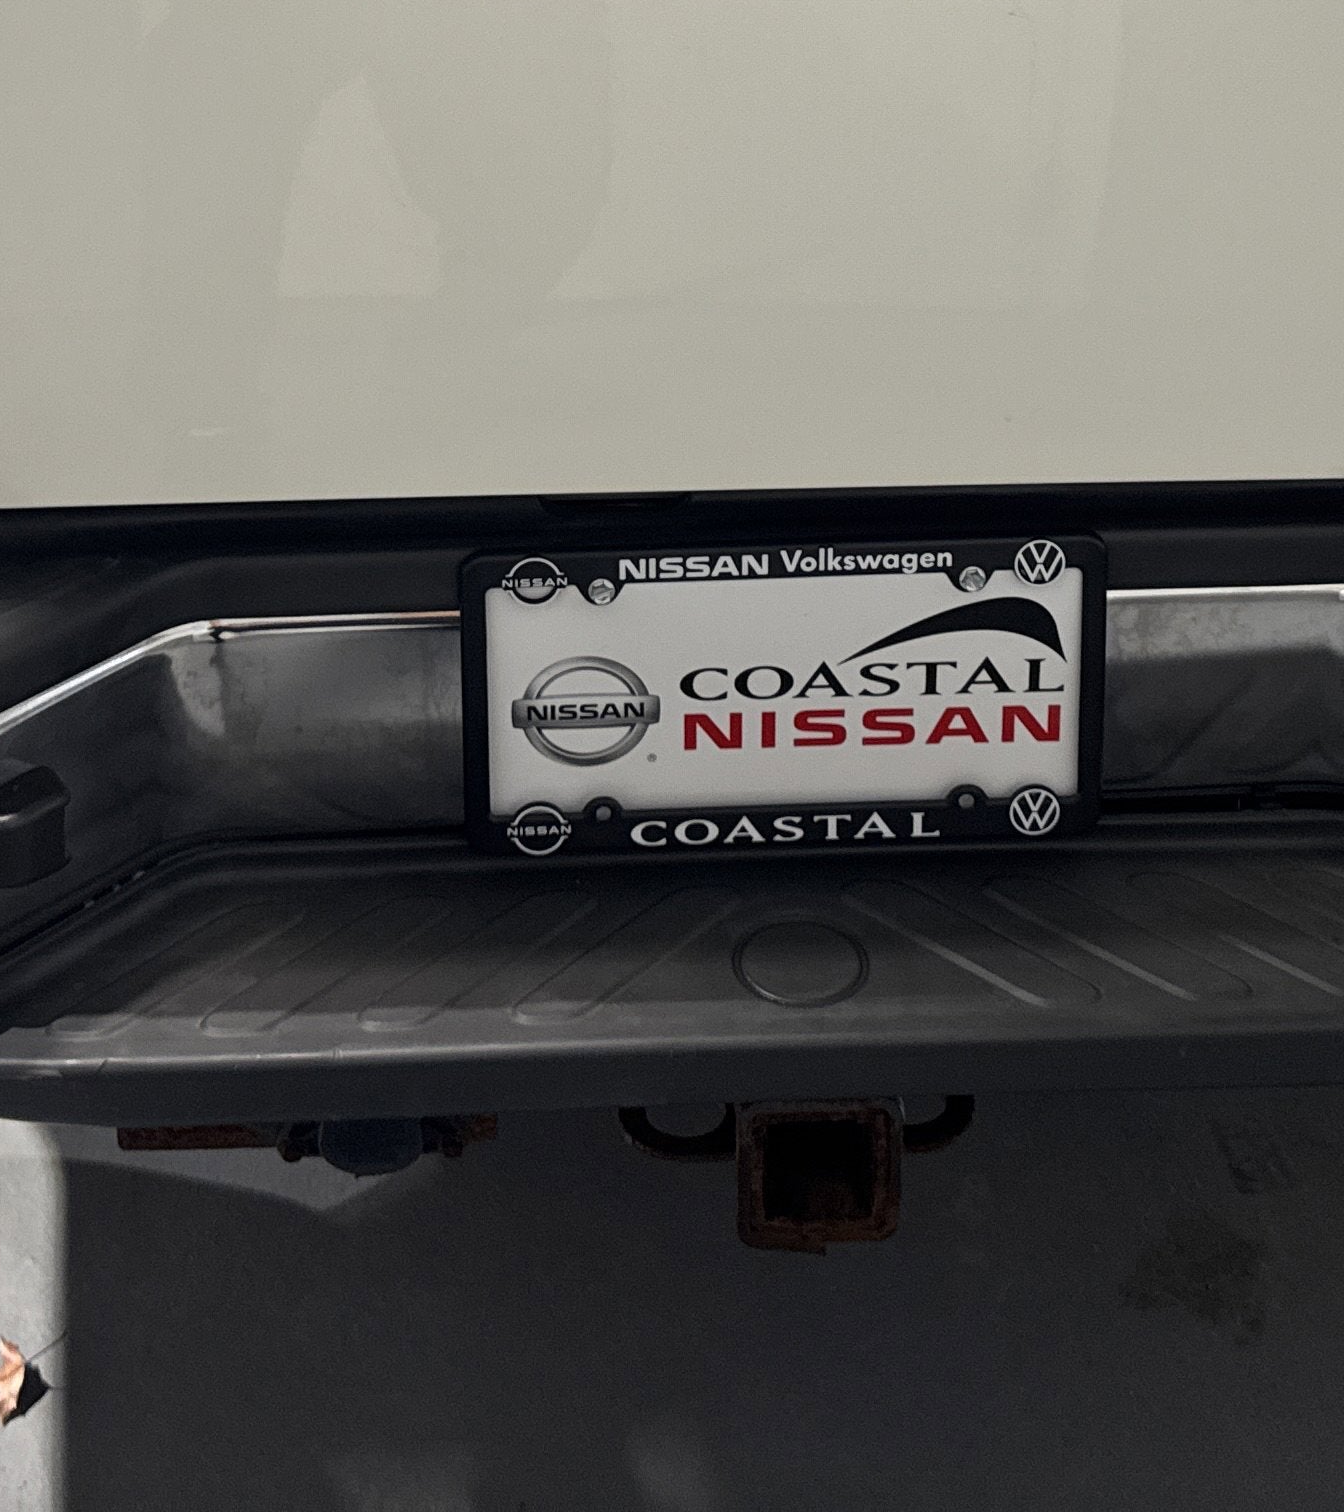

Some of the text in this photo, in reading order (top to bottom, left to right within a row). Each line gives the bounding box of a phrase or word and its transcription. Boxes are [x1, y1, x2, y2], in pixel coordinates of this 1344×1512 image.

[618, 546, 953, 581] NISSAN Volkswagen
[501, 577, 568, 589] NISSAN
[679, 656, 1065, 701] COASTAL
[527, 701, 645, 721] NISSAN
[683, 705, 1061, 750] NISSAN
[507, 824, 572, 837] NISSAN
[631, 811, 941, 846] COASTAL
